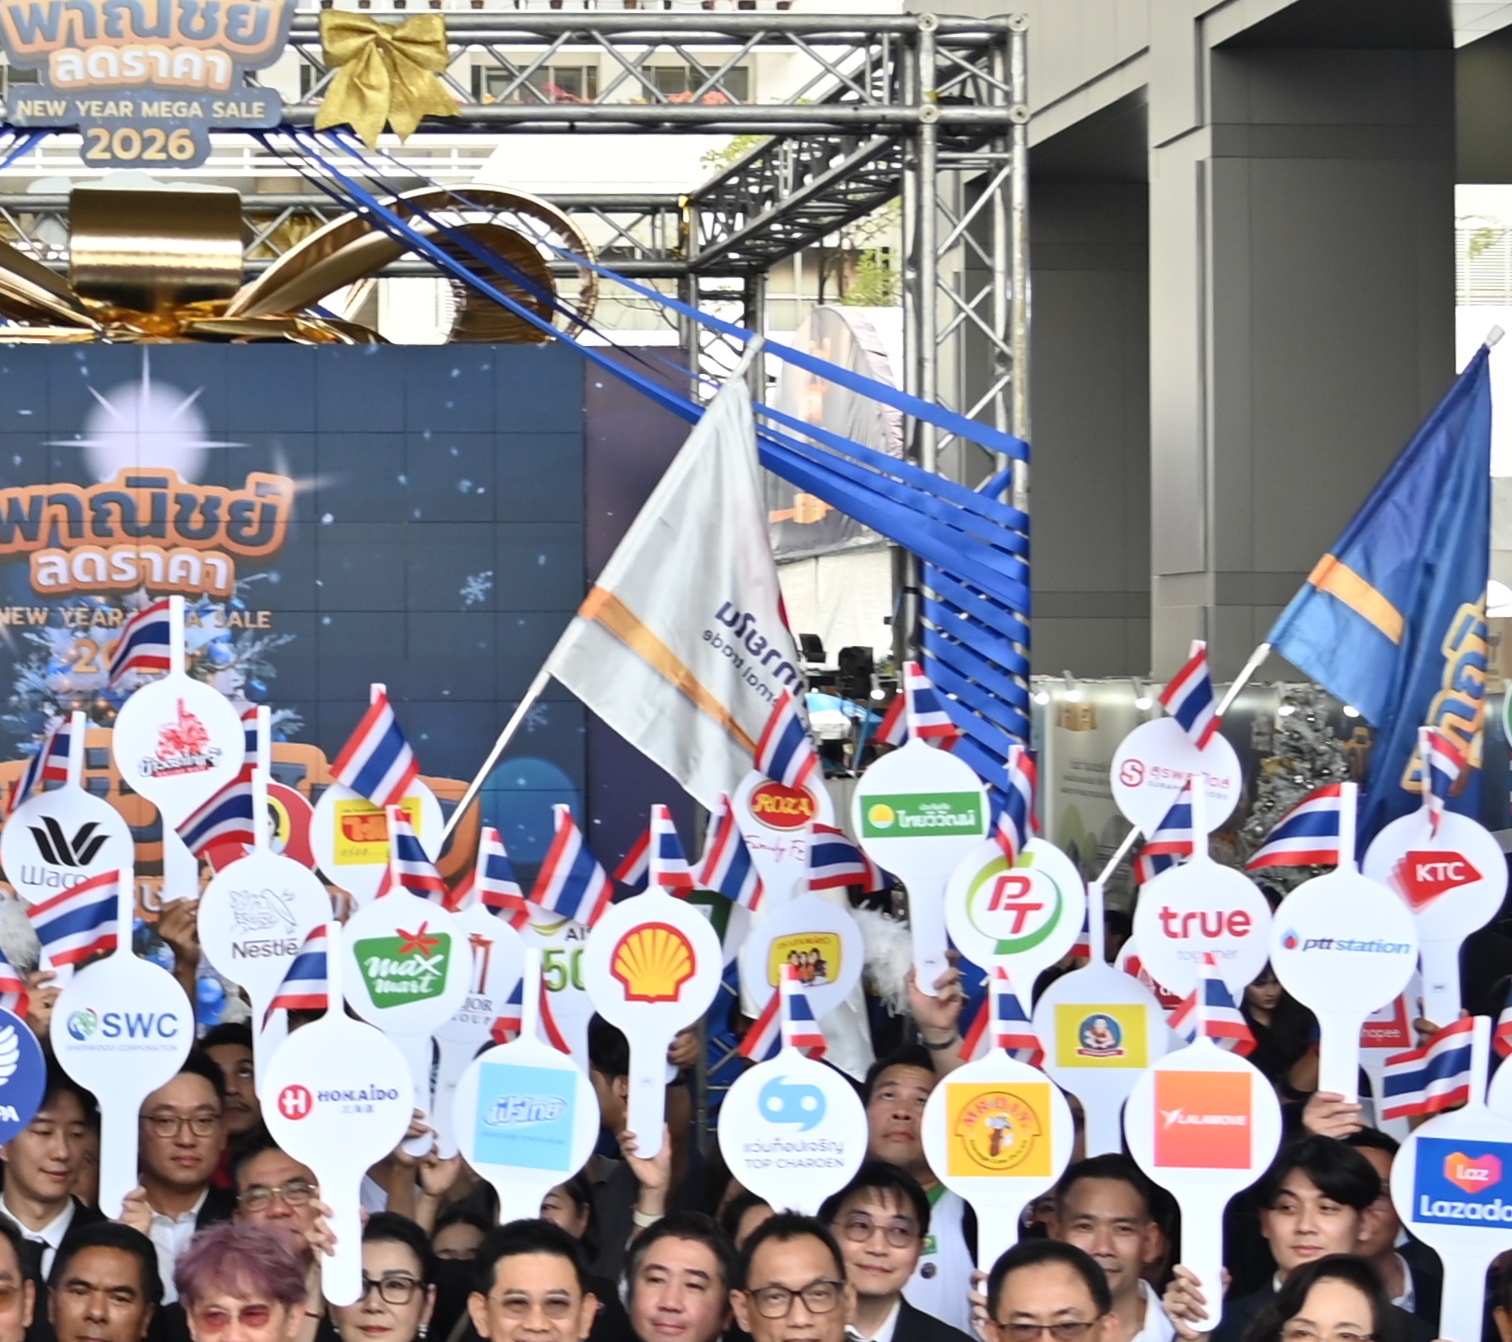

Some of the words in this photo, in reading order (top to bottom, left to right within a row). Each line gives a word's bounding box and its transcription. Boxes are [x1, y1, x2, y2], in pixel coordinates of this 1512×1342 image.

[51, 46, 227, 83] ลดราคา
[18, 100, 67, 118] NEW
[77, 100, 133, 118] YEAR
[140, 100, 202, 118] MEGA
[211, 100, 265, 119] SALE
[86, 129, 195, 160] 2026
[36, 551, 231, 589] ลดราคา
[61, 607, 123, 628] YEAR
[216, 609, 271, 629] SALE
[753, 793, 812, 817] ROZA
[19, 864, 88, 891] Waco
[1416, 861, 1466, 882] KTC
[987, 874, 1044, 935] PT
[1158, 905, 1252, 939] true
[101, 1011, 179, 1040] SWC
[1362, 1027, 1402, 1040] hopee
[1175, 1112, 1248, 1127] LALAMOVE
[745, 1159, 770, 1170] TOP
[772, 1158, 845, 1170] CHAROEN
[1455, 1162, 1490, 1182] Laz
